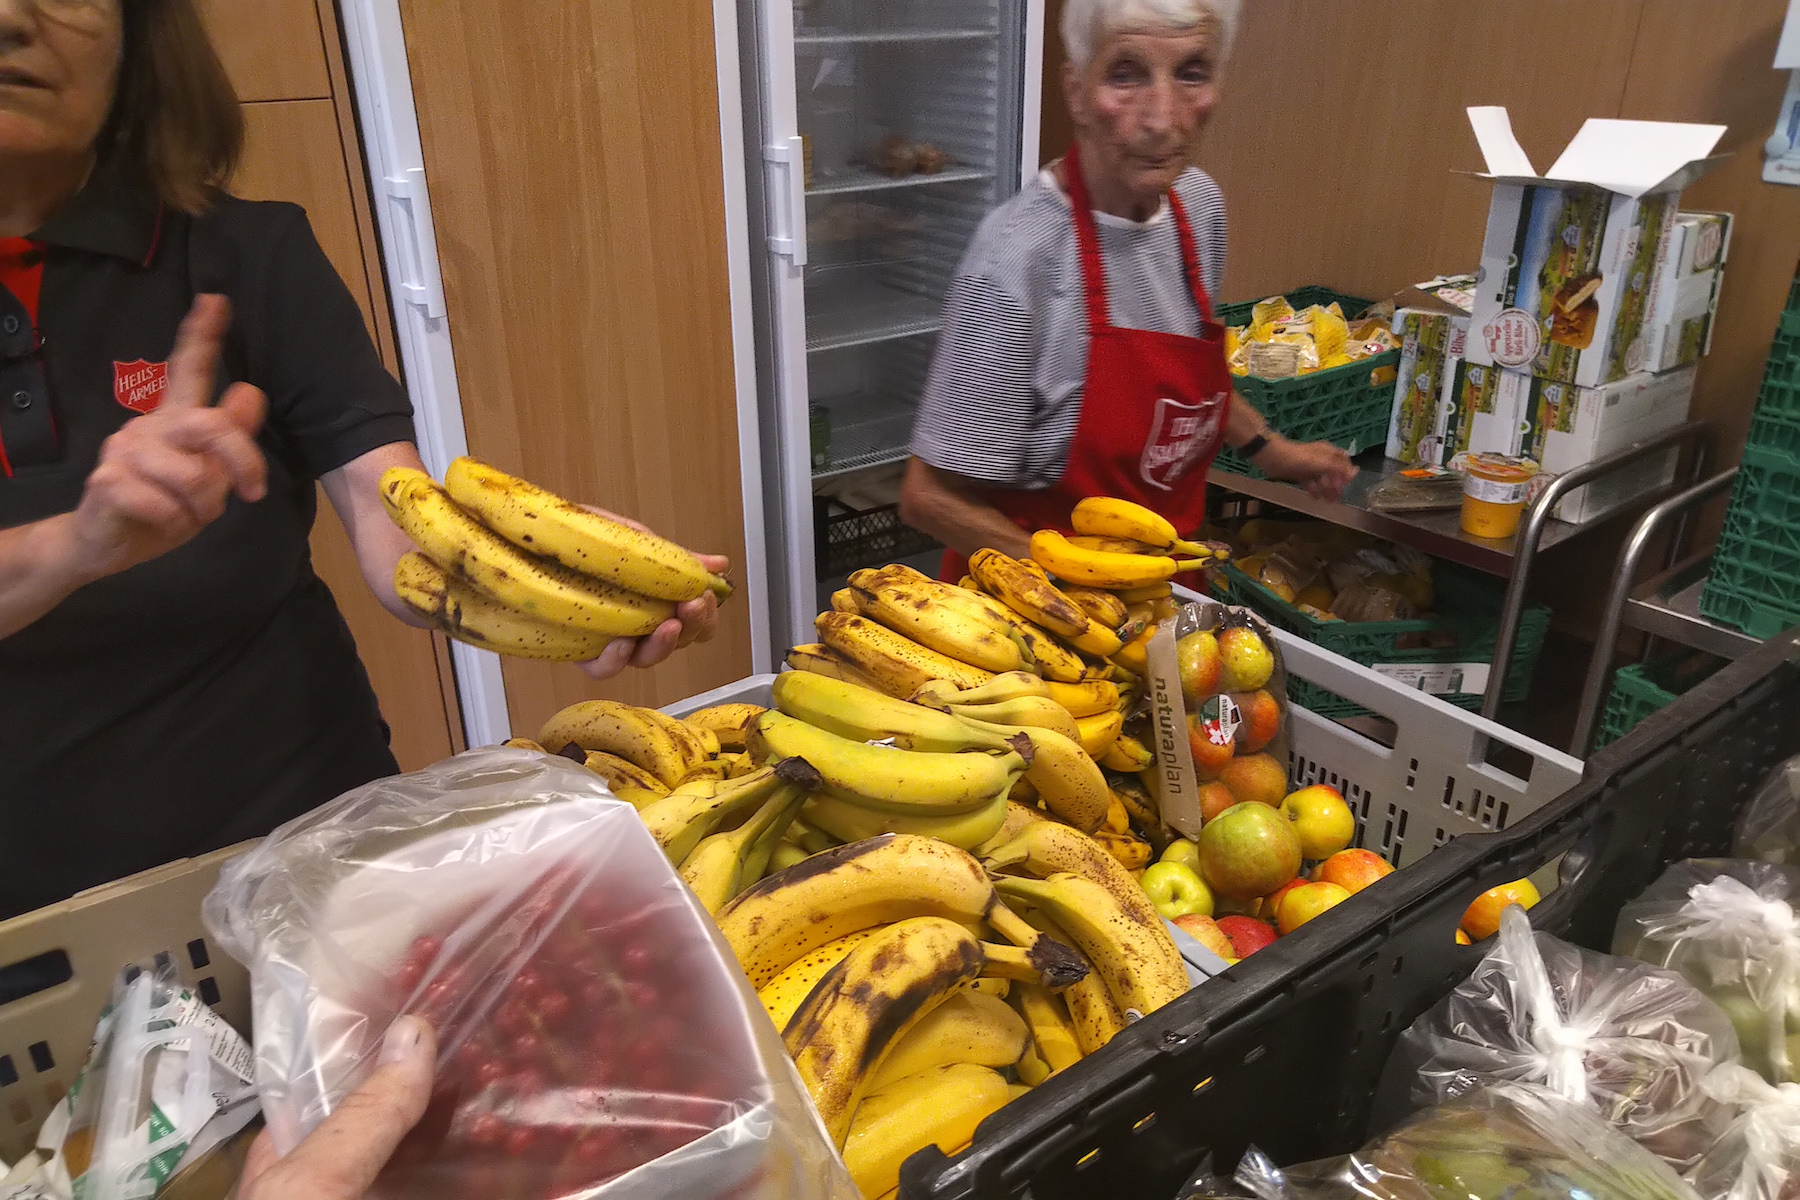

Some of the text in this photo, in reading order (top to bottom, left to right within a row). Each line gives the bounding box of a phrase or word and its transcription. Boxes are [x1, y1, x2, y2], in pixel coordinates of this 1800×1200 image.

[119, 365, 159, 393] HEILS-
[127, 375, 167, 405] ARMEE
[1153, 677, 1182, 795] naturaplan
[1220, 698, 1230, 739] naturaplan
